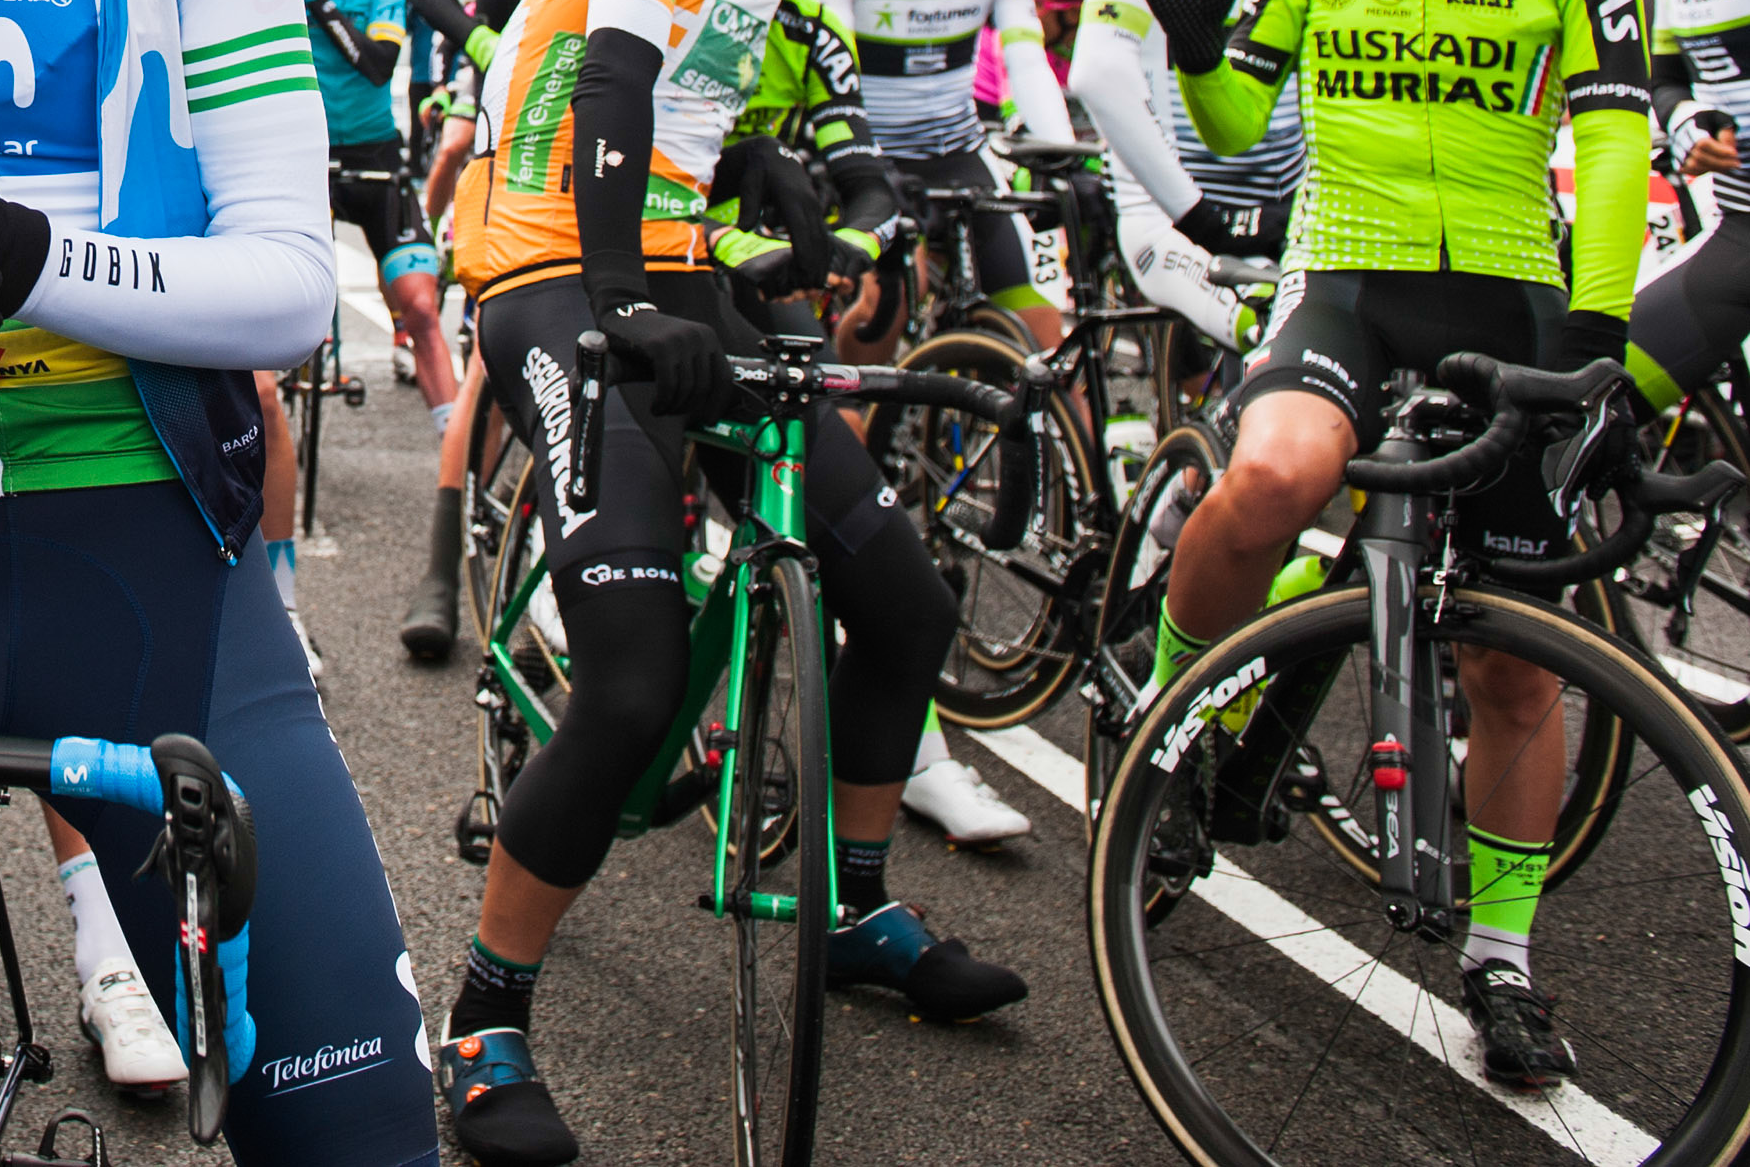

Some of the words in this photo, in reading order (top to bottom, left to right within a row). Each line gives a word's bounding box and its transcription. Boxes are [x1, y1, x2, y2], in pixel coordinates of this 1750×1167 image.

[1314, 30, 1517, 72] EUSKADI
[1316, 70, 1515, 114] MURIAS
[59, 238, 166, 294] GOBIK
[1032, 235, 1058, 284] 243
[1482, 531, 1549, 556] kalas
[632, 567, 679, 583] ROSA
